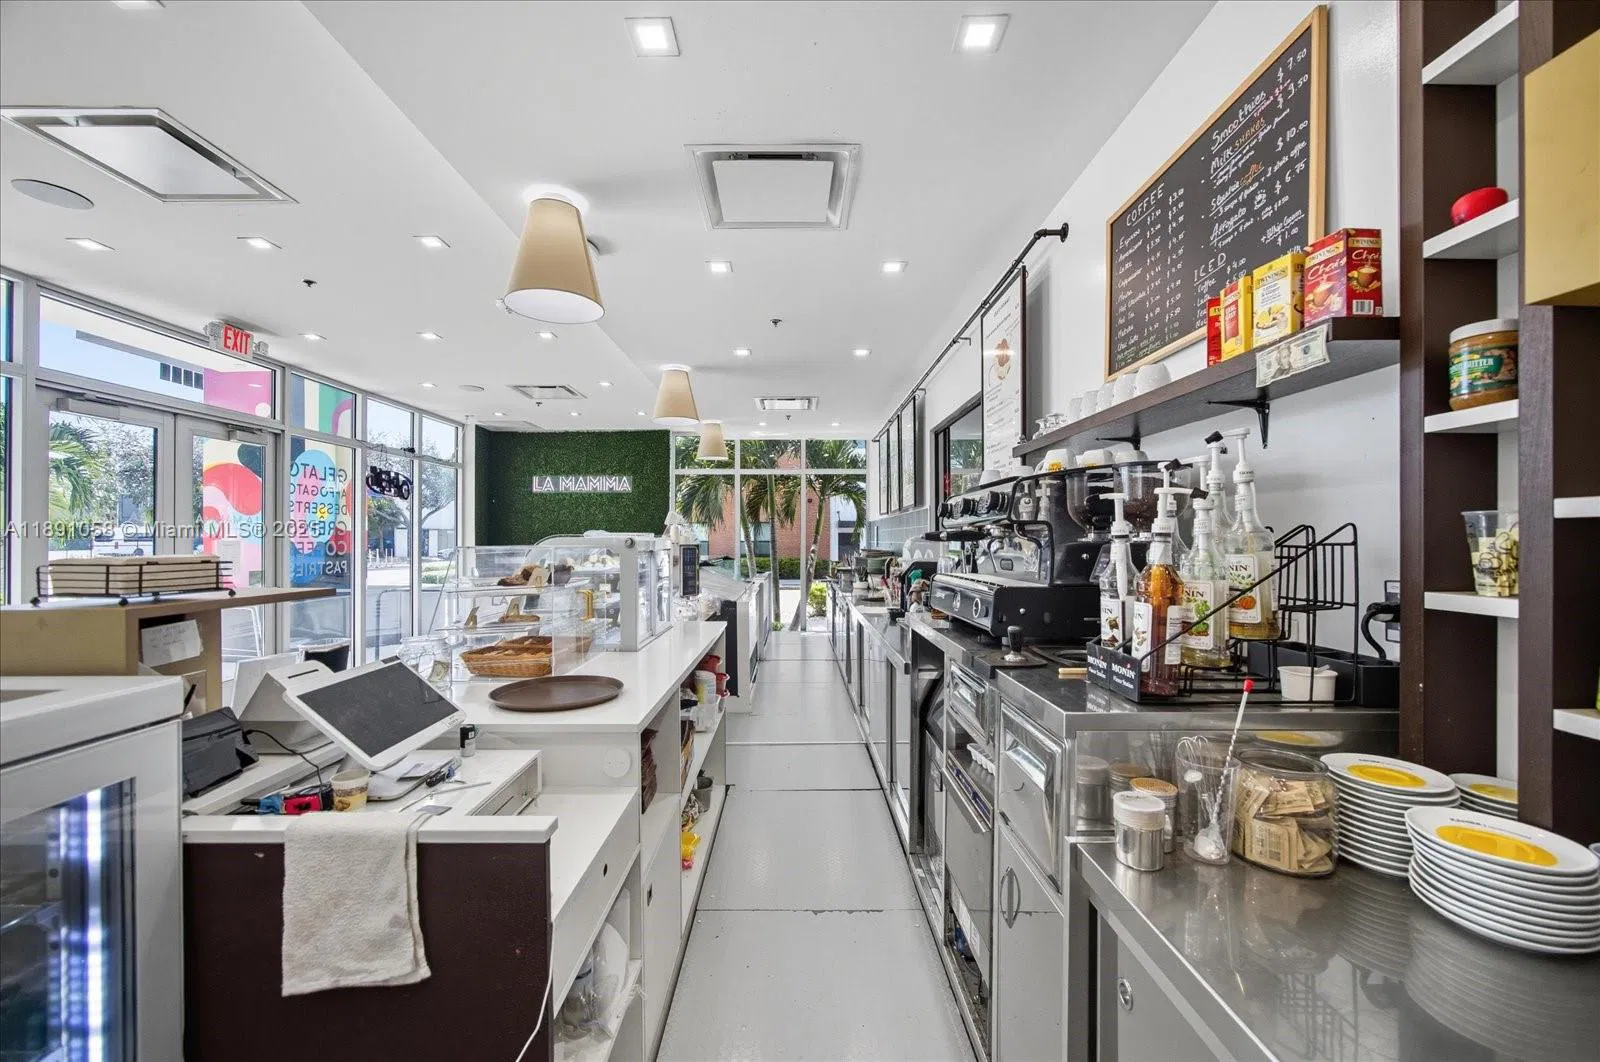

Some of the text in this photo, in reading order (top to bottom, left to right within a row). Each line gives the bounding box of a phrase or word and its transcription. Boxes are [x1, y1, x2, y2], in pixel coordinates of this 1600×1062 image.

[1212, 92, 1266, 149] Smoothies
[1287, 48, 1307, 70] 7.50
[1211, 147, 1234, 174] Milk
[1288, 74, 1309, 99] 9.50
[1285, 159, 1307, 182] 6.75
[1126, 183, 1164, 226] COFFEE
[1194, 253, 1226, 281] ICED
[224, 326, 251, 354] EXIT
[533, 476, 631, 491] LA MAMMA
[1111, 663, 1136, 679] MONIN
